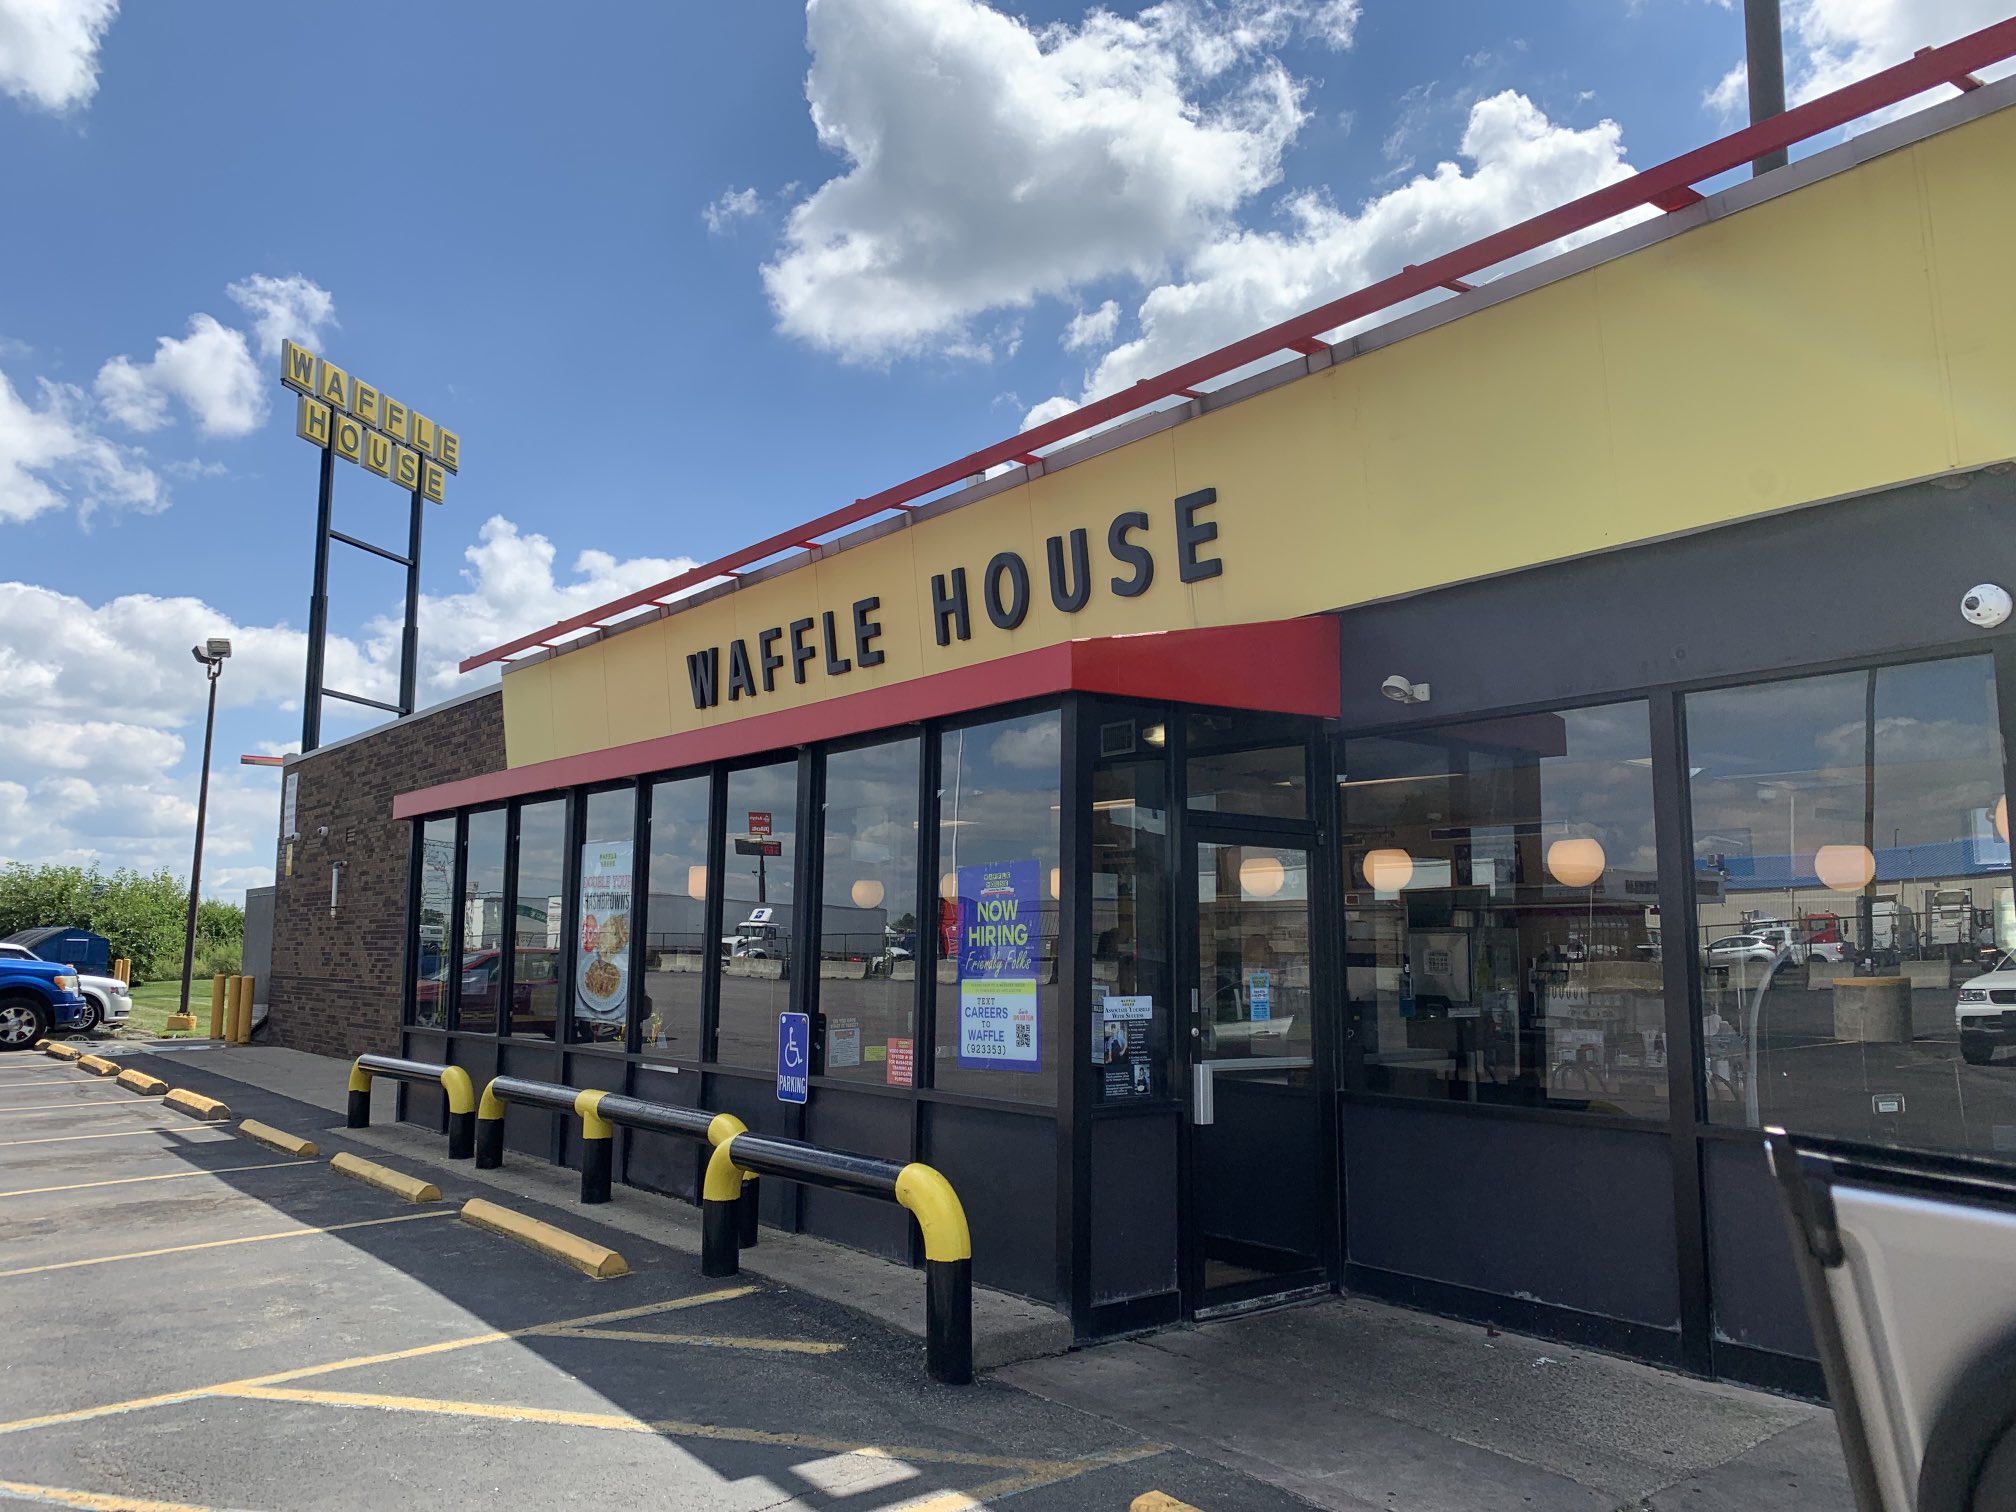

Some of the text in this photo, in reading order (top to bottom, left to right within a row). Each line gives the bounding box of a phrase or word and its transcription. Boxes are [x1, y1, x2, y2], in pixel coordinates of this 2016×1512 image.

[292, 348, 457, 463] WAFFLE
[309, 405, 442, 496] HOUSE
[686, 487, 1222, 709] WAFFLE HOUSE
[583, 875, 610, 889] DOUBLE
[584, 891, 630, 910] HASHBROWNS
[977, 899, 1018, 923] NOW
[968, 923, 1028, 947] HIRING
[965, 949, 1032, 977] Friendly Folks
[977, 997, 996, 1006] TEXT
[964, 1006, 1008, 1019] CAREERS
[981, 1020, 991, 1028] TO
[968, 1029, 1005, 1042] WAFFLE
[966, 1044, 1006, 1055] (923353)
[778, 1074, 806, 1094] PARKING
